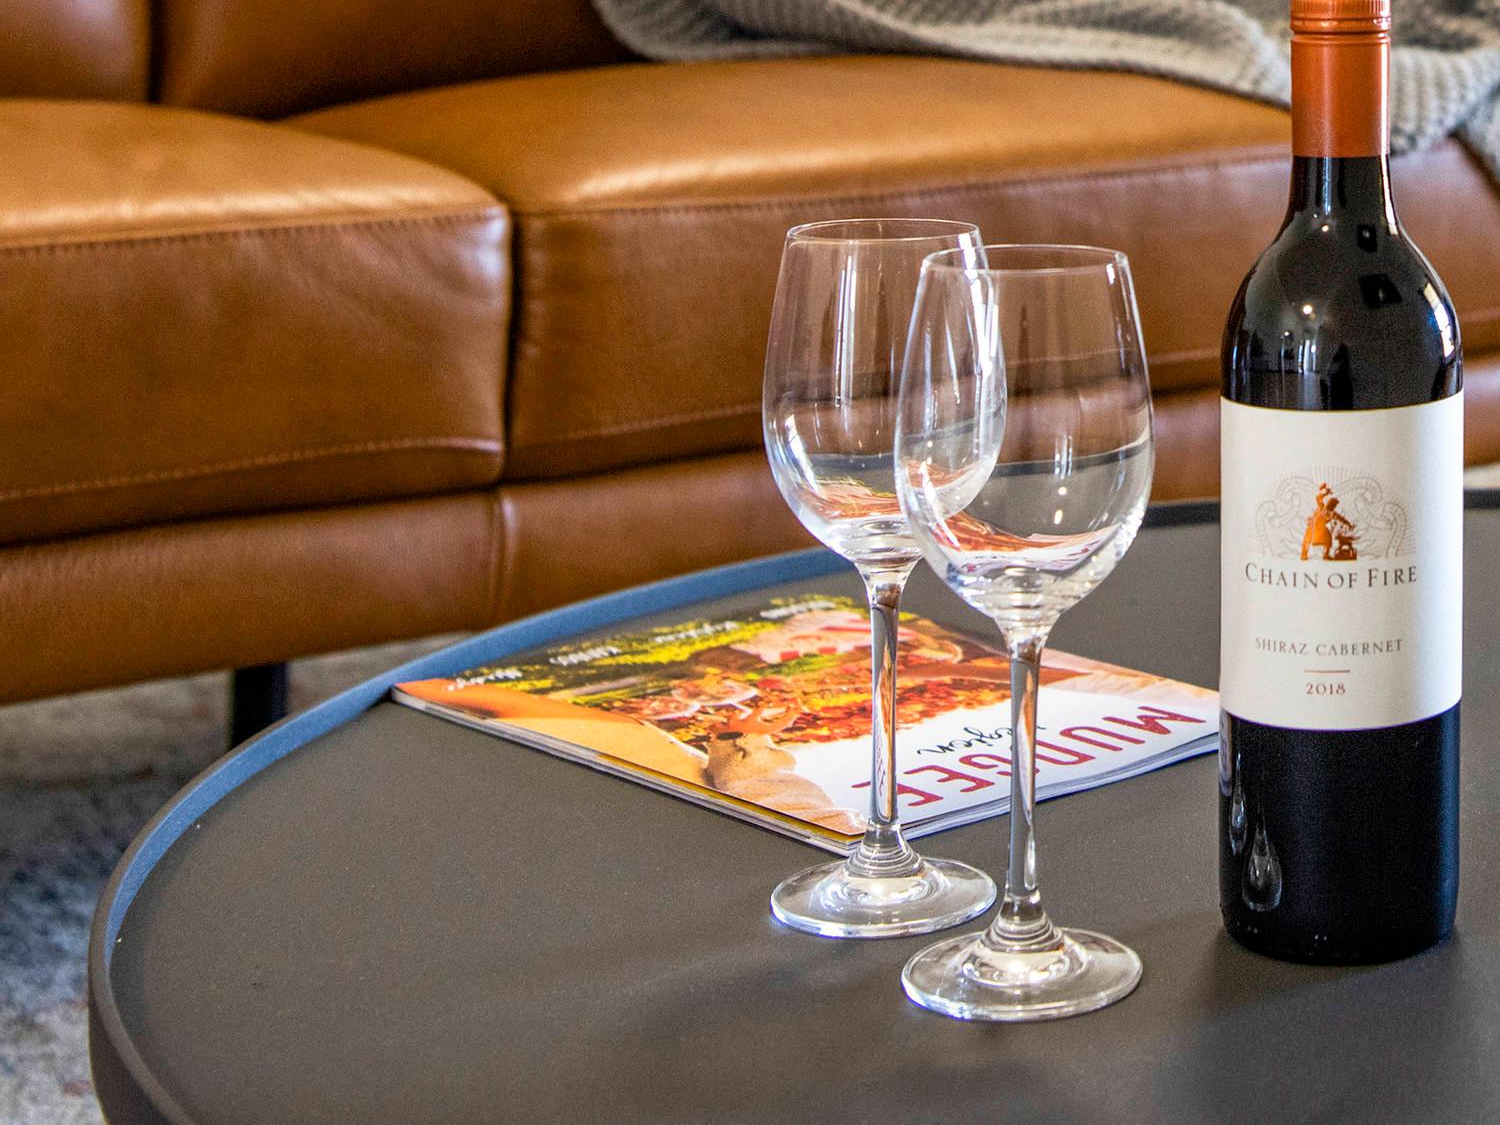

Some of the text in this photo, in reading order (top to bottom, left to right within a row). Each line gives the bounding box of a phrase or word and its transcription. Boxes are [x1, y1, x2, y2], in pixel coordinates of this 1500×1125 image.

[1245, 562, 1418, 589] CHAIN OF FIRE
[1255, 637, 1403, 656] SHIRAZ CABERNET
[1306, 683, 1346, 696] 2018
